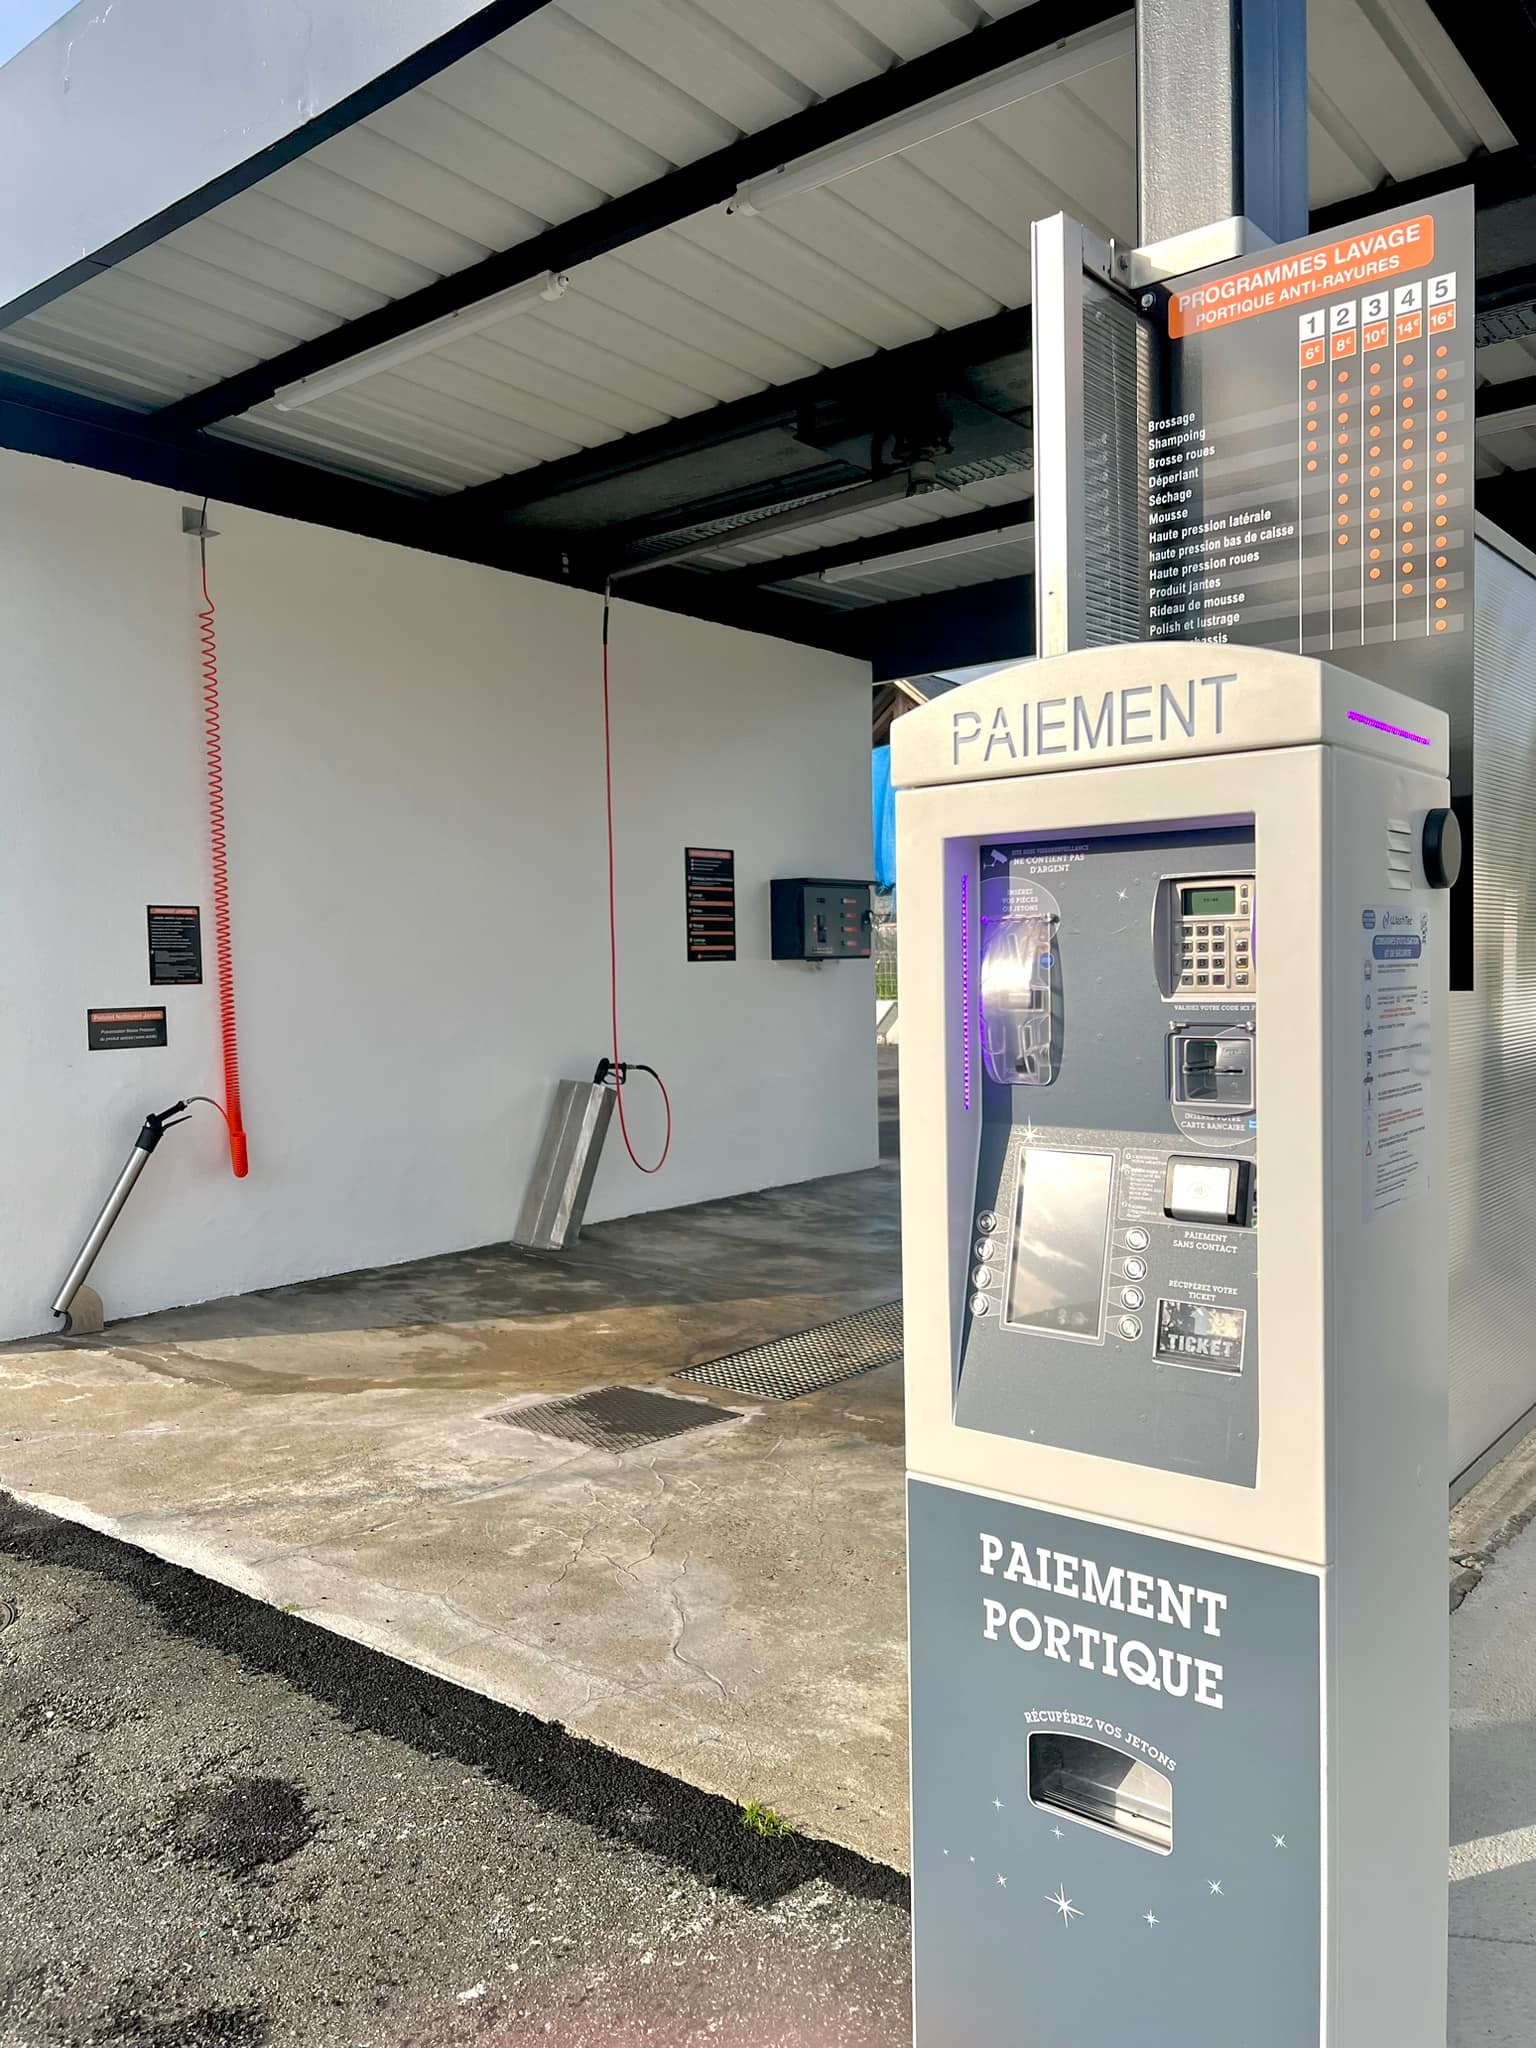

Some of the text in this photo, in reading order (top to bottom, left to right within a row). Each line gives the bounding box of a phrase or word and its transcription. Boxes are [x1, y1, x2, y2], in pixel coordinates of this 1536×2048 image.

[1178, 223, 1421, 313] PROGRAMMES LAVAGE
[1195, 255, 1401, 326] PORTIQUE ANTI-RAYURES
[1306, 279, 1449, 334] 1 2 3 4 5
[1148, 412, 1196, 432] Brossage
[1148, 428, 1206, 451] Shampoing
[1148, 446, 1216, 470] Brosse roues
[1148, 467, 1199, 488] Déperlant
[1148, 489, 1193, 507] Séchage
[1148, 508, 1189, 526] Mousse
[1149, 508, 1272, 544] Haute pression latérale
[1149, 524, 1294, 563] haute pression bas de caisse
[1149, 551, 1260, 581] Haute pression roues
[1149, 577, 1221, 600] Produit jantes
[1149, 591, 1246, 618] Rideau de mousse
[1149, 612, 1241, 637] Polish et lustrage
[953, 673, 1238, 765] PAIEMENT
[1013, 853, 1085, 866] NE CONTIENT PAS
[1030, 864, 1070, 874] D'ARGENT
[1181, 1121, 1246, 1132] CARTE BANCAIRE
[1173, 1240, 1238, 1254] SANS CONTACT
[1184, 1231, 1228, 1243] PAIEMENT
[1188, 1292, 1216, 1302] TICKET
[1213, 1285, 1238, 1295] VOTRE
[1167, 1334, 1233, 1358] TICKET
[979, 1532, 1227, 1637] PAIEMENT
[983, 1598, 1224, 1710] PORTIQUE
[1024, 1708, 1177, 1772] RÉCUPÉREZ VOS JETONS
